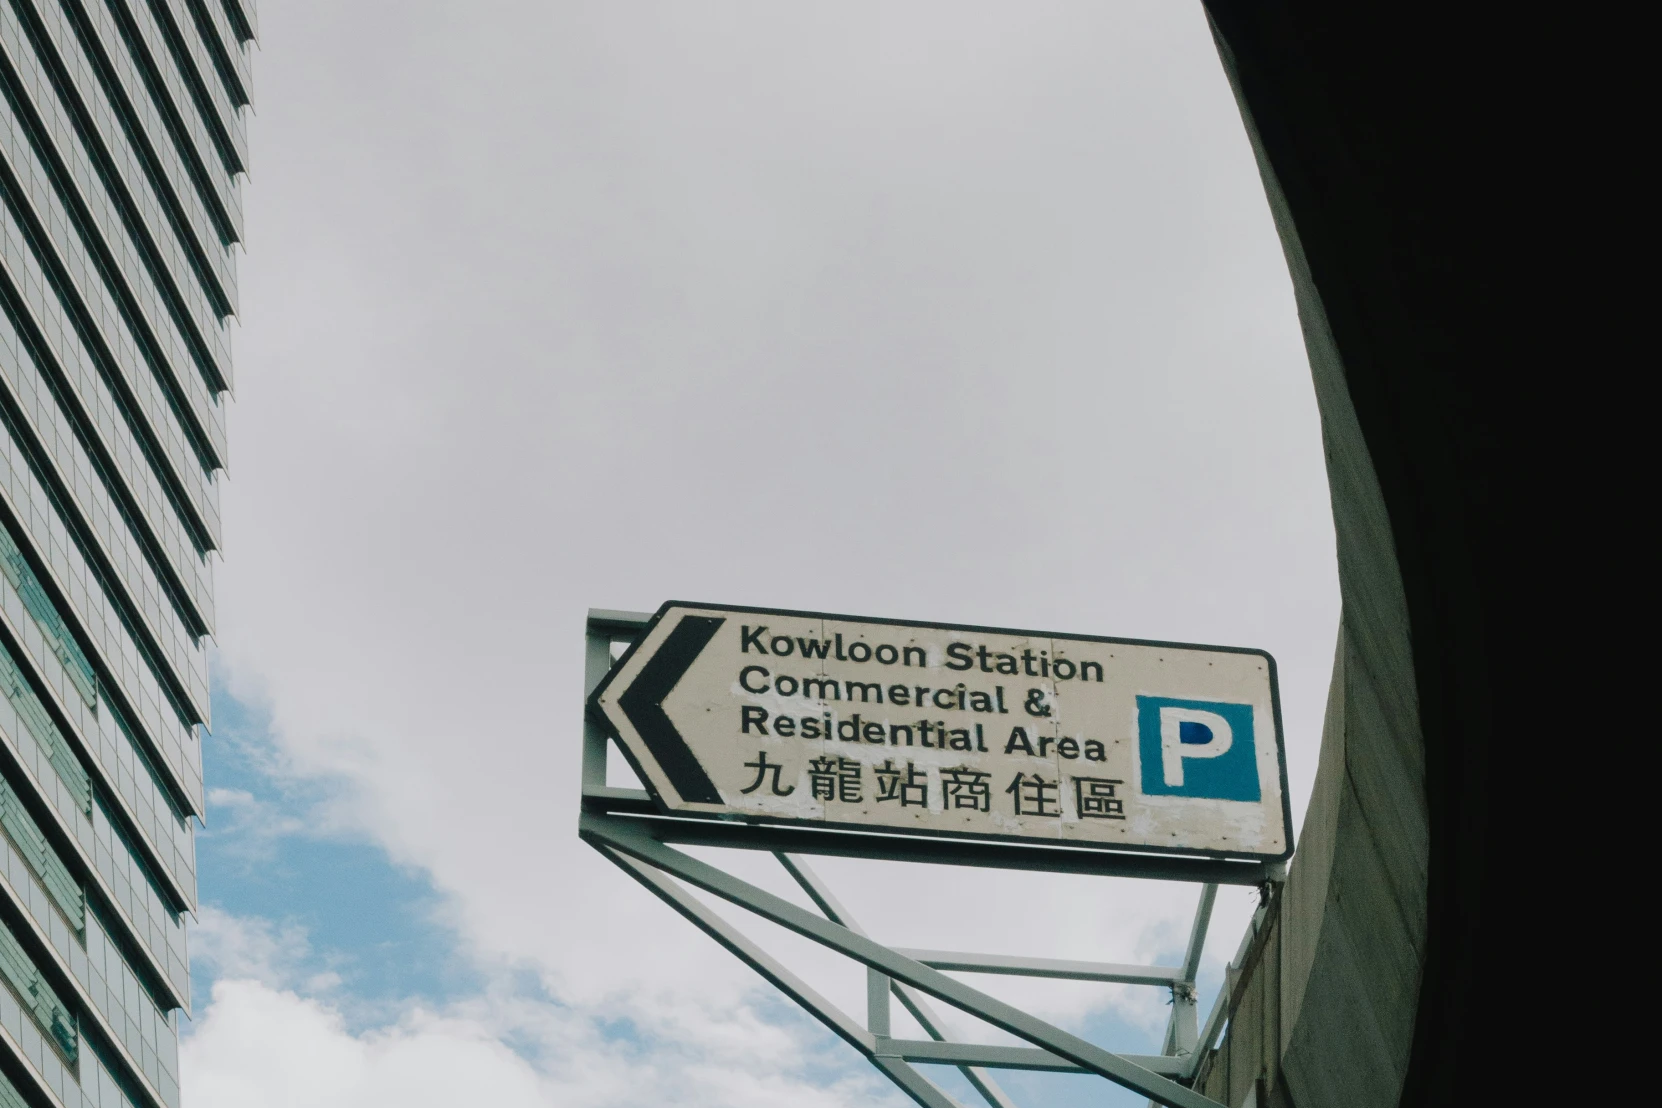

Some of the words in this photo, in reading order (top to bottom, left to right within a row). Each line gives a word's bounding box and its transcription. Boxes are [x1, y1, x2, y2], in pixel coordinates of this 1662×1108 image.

[740, 625, 927, 668] Kowloon
[945, 641, 1105, 683] Station
[739, 665, 1008, 714] Commercial
[1024, 687, 1053, 717] &
[741, 705, 989, 753] Residential
[1004, 727, 1107, 762] Area
[1159, 707, 1234, 787] P
[740, 751, 1127, 821] 九龍站商住區
